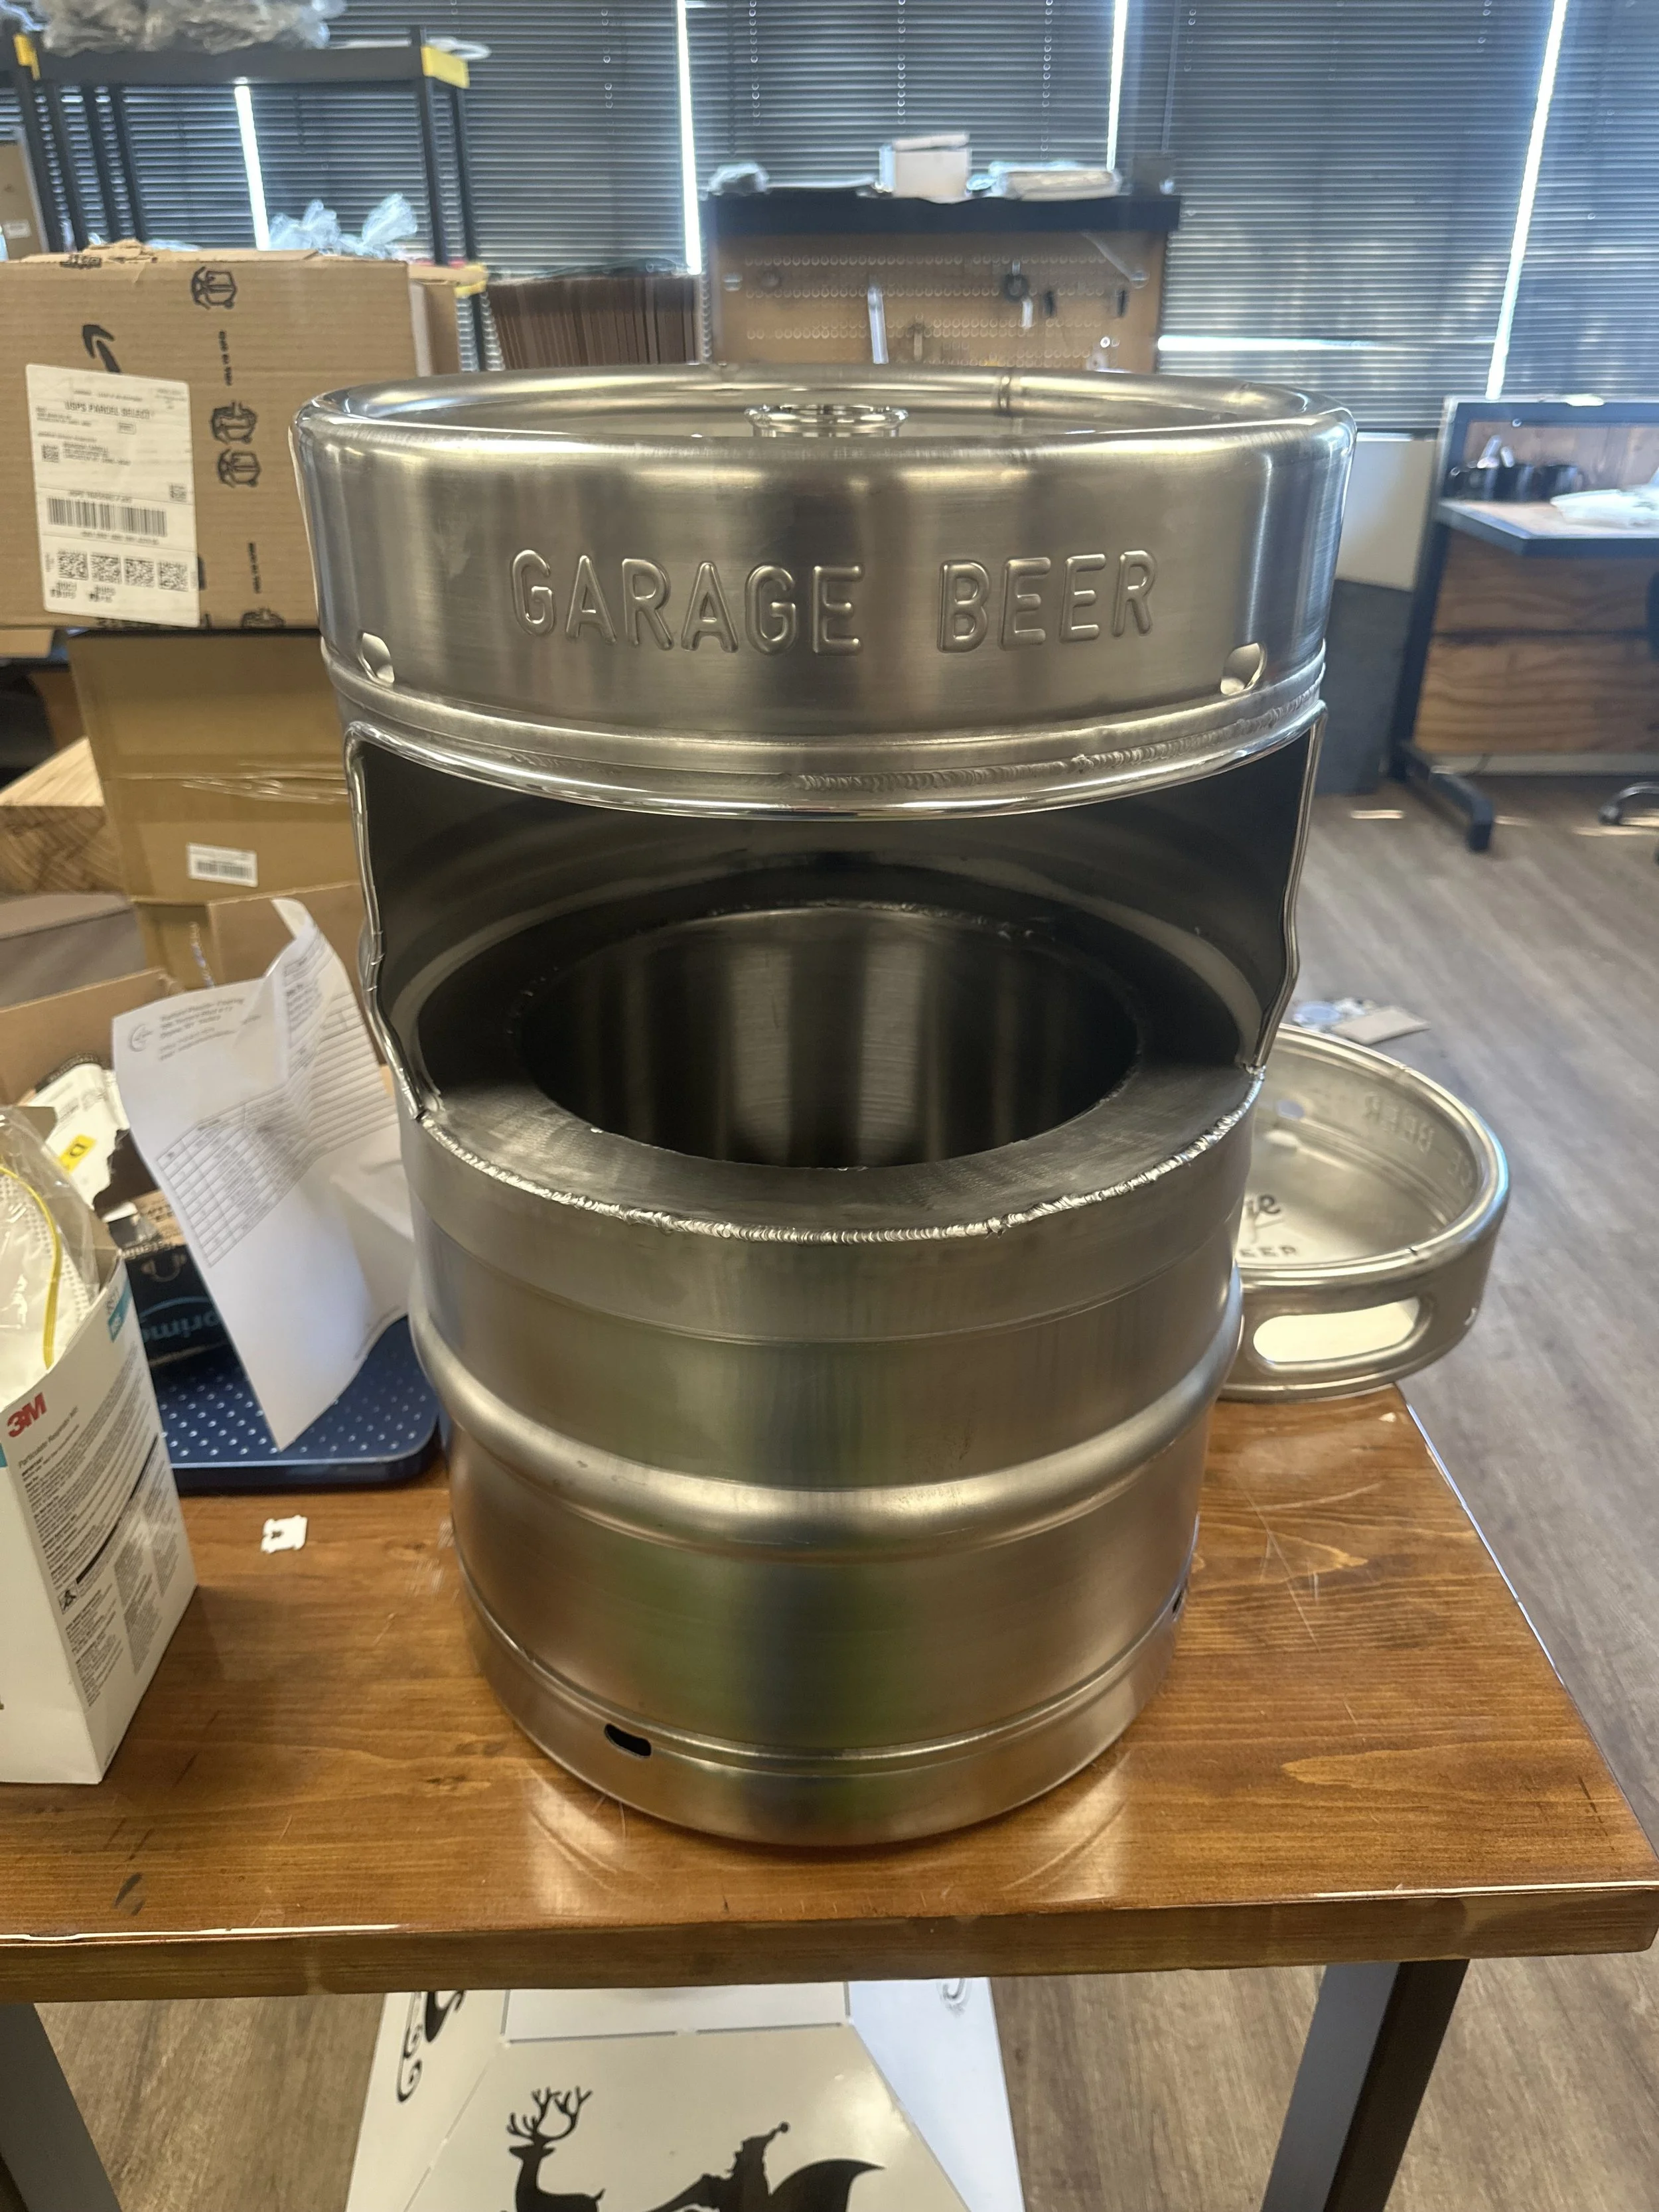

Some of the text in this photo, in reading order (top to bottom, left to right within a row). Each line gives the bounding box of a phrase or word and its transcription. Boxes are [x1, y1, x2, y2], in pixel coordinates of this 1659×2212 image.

[511, 548, 1157, 656] GARAGE BEER
[7, 1392, 47, 1438] 3M
